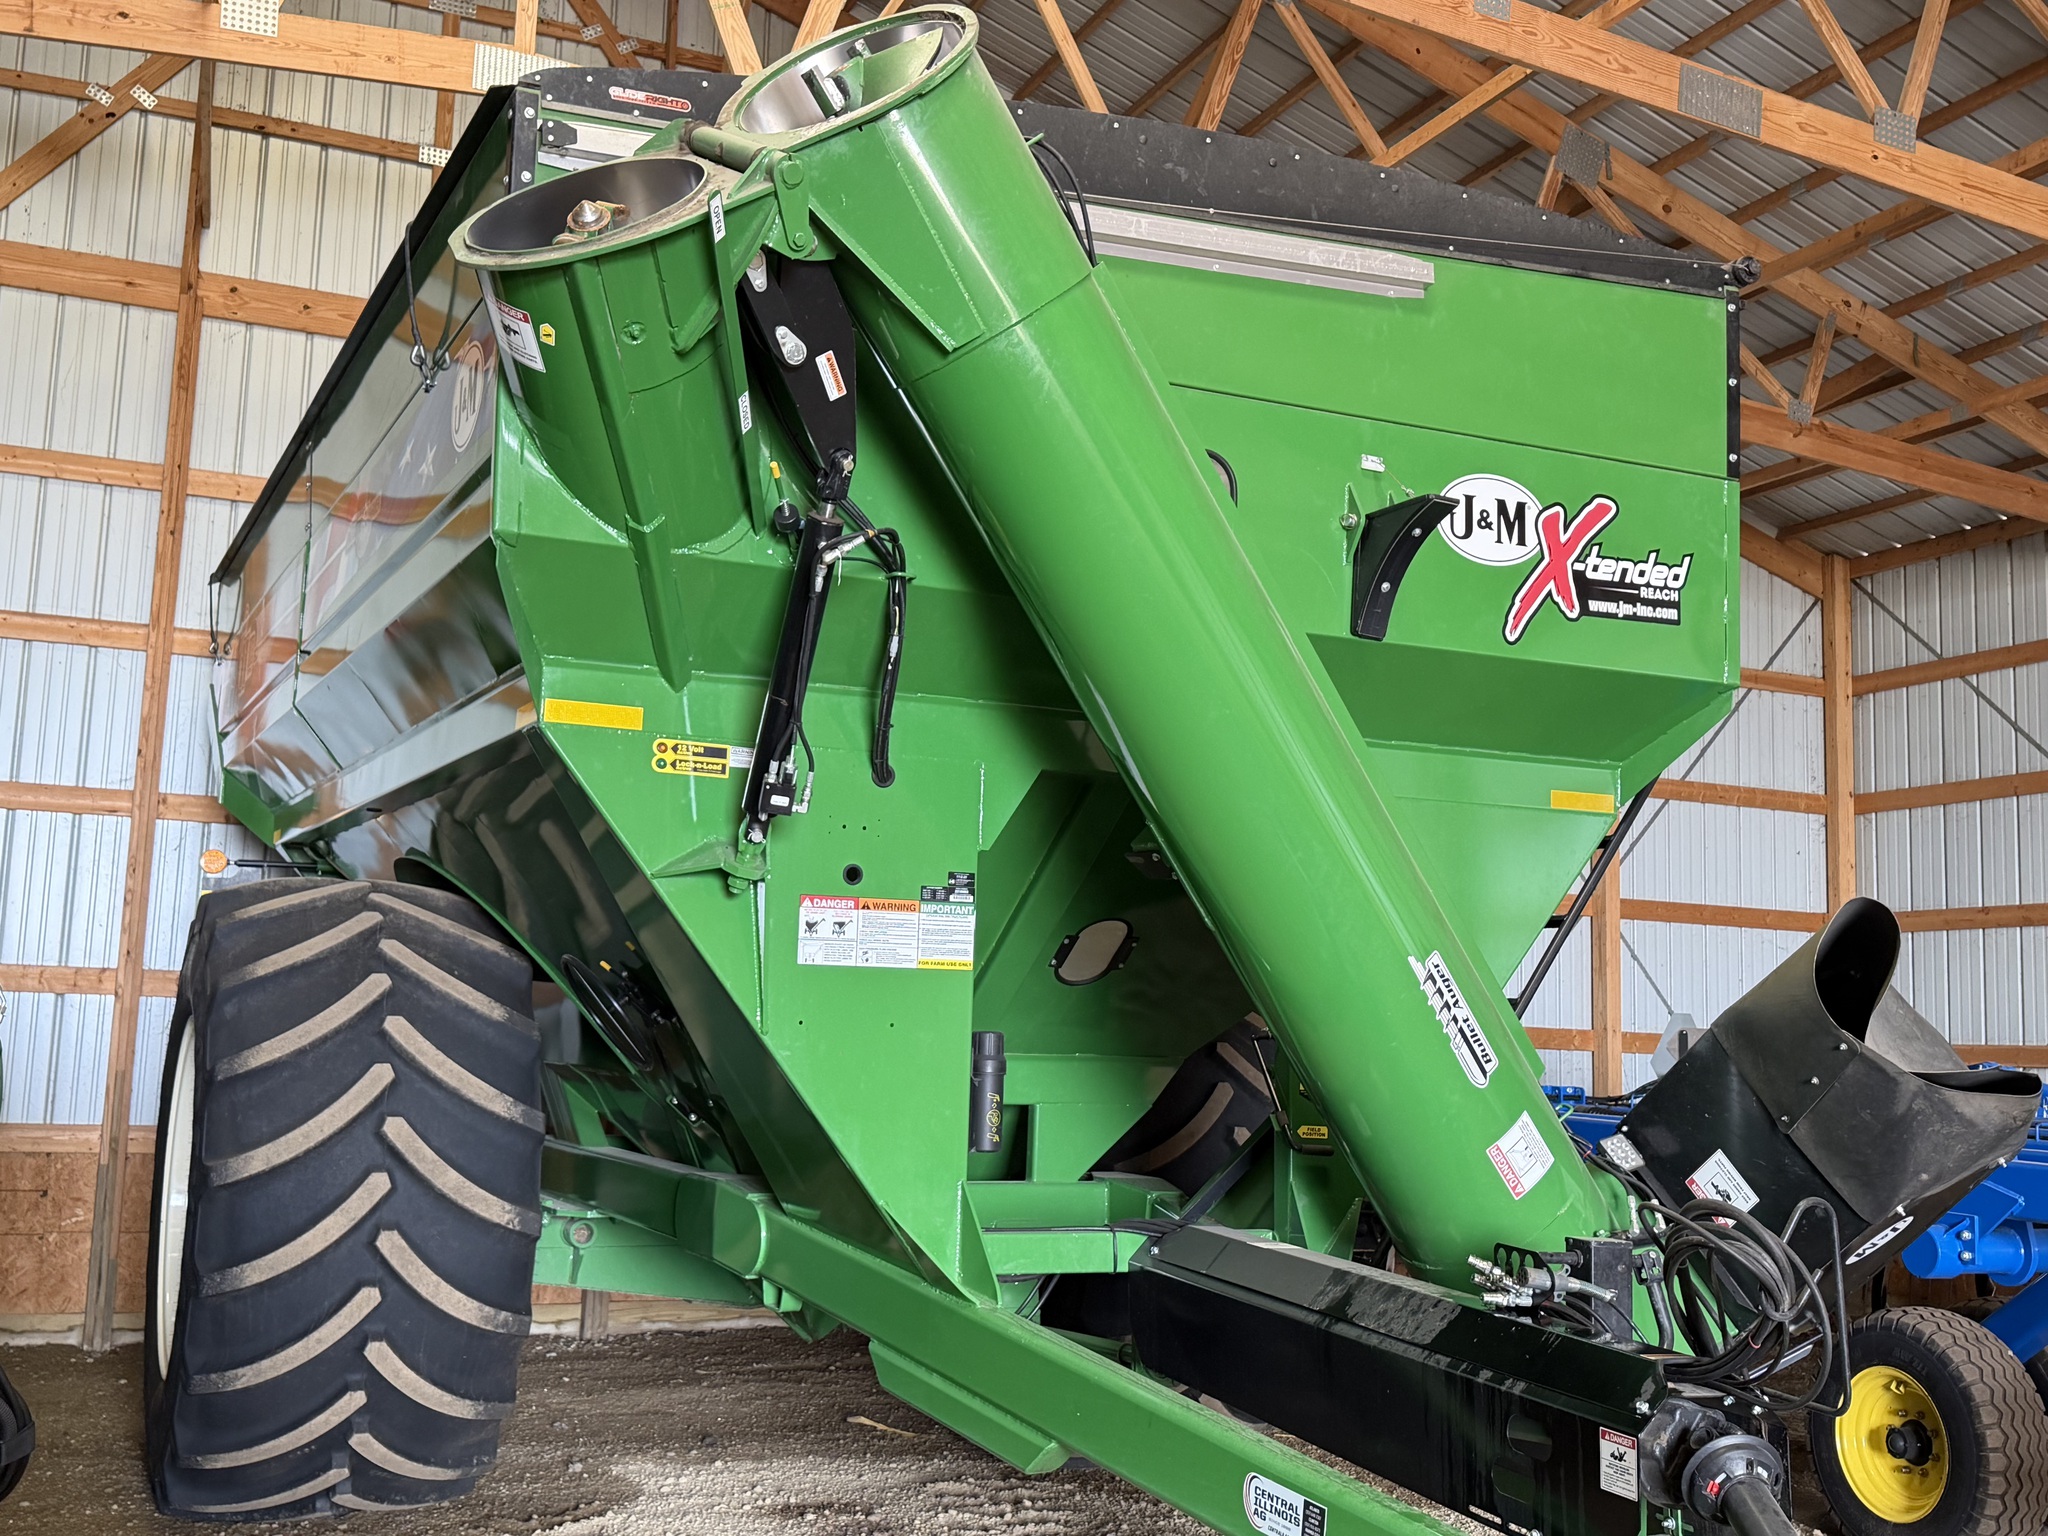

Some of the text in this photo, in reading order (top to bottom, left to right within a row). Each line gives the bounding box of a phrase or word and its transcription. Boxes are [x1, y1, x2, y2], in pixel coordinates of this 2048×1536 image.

[713, 205, 722, 234] OPEN
[829, 360, 844, 391] WARNING
[453, 357, 481, 436] J&M
[741, 394, 749, 430] CLOSED
[1450, 494, 1528, 547] J&M
[1505, 496, 1693, 643] X-tended
[1640, 586, 1679, 601] REACH
[1588, 600, 1678, 620] www.jm-inc.com
[677, 744, 705, 754] 12 Volt
[675, 759, 723, 770] Lock-n-Load
[813, 898, 855, 909] DANGER
[872, 901, 917, 912] WARNING
[920, 903, 975, 915] IMPORTANT
[1432, 961, 1492, 1065] Bullet Auger
[1489, 1145, 1520, 1188] DANGER
[1853, 1220, 1907, 1258] J&M
[1610, 1433, 1633, 1448] DANGER
[1253, 1496, 1301, 1527] ILLINOIS
[1253, 1507, 1267, 1521] AG
[1254, 1485, 1301, 1517] CENTRAL
